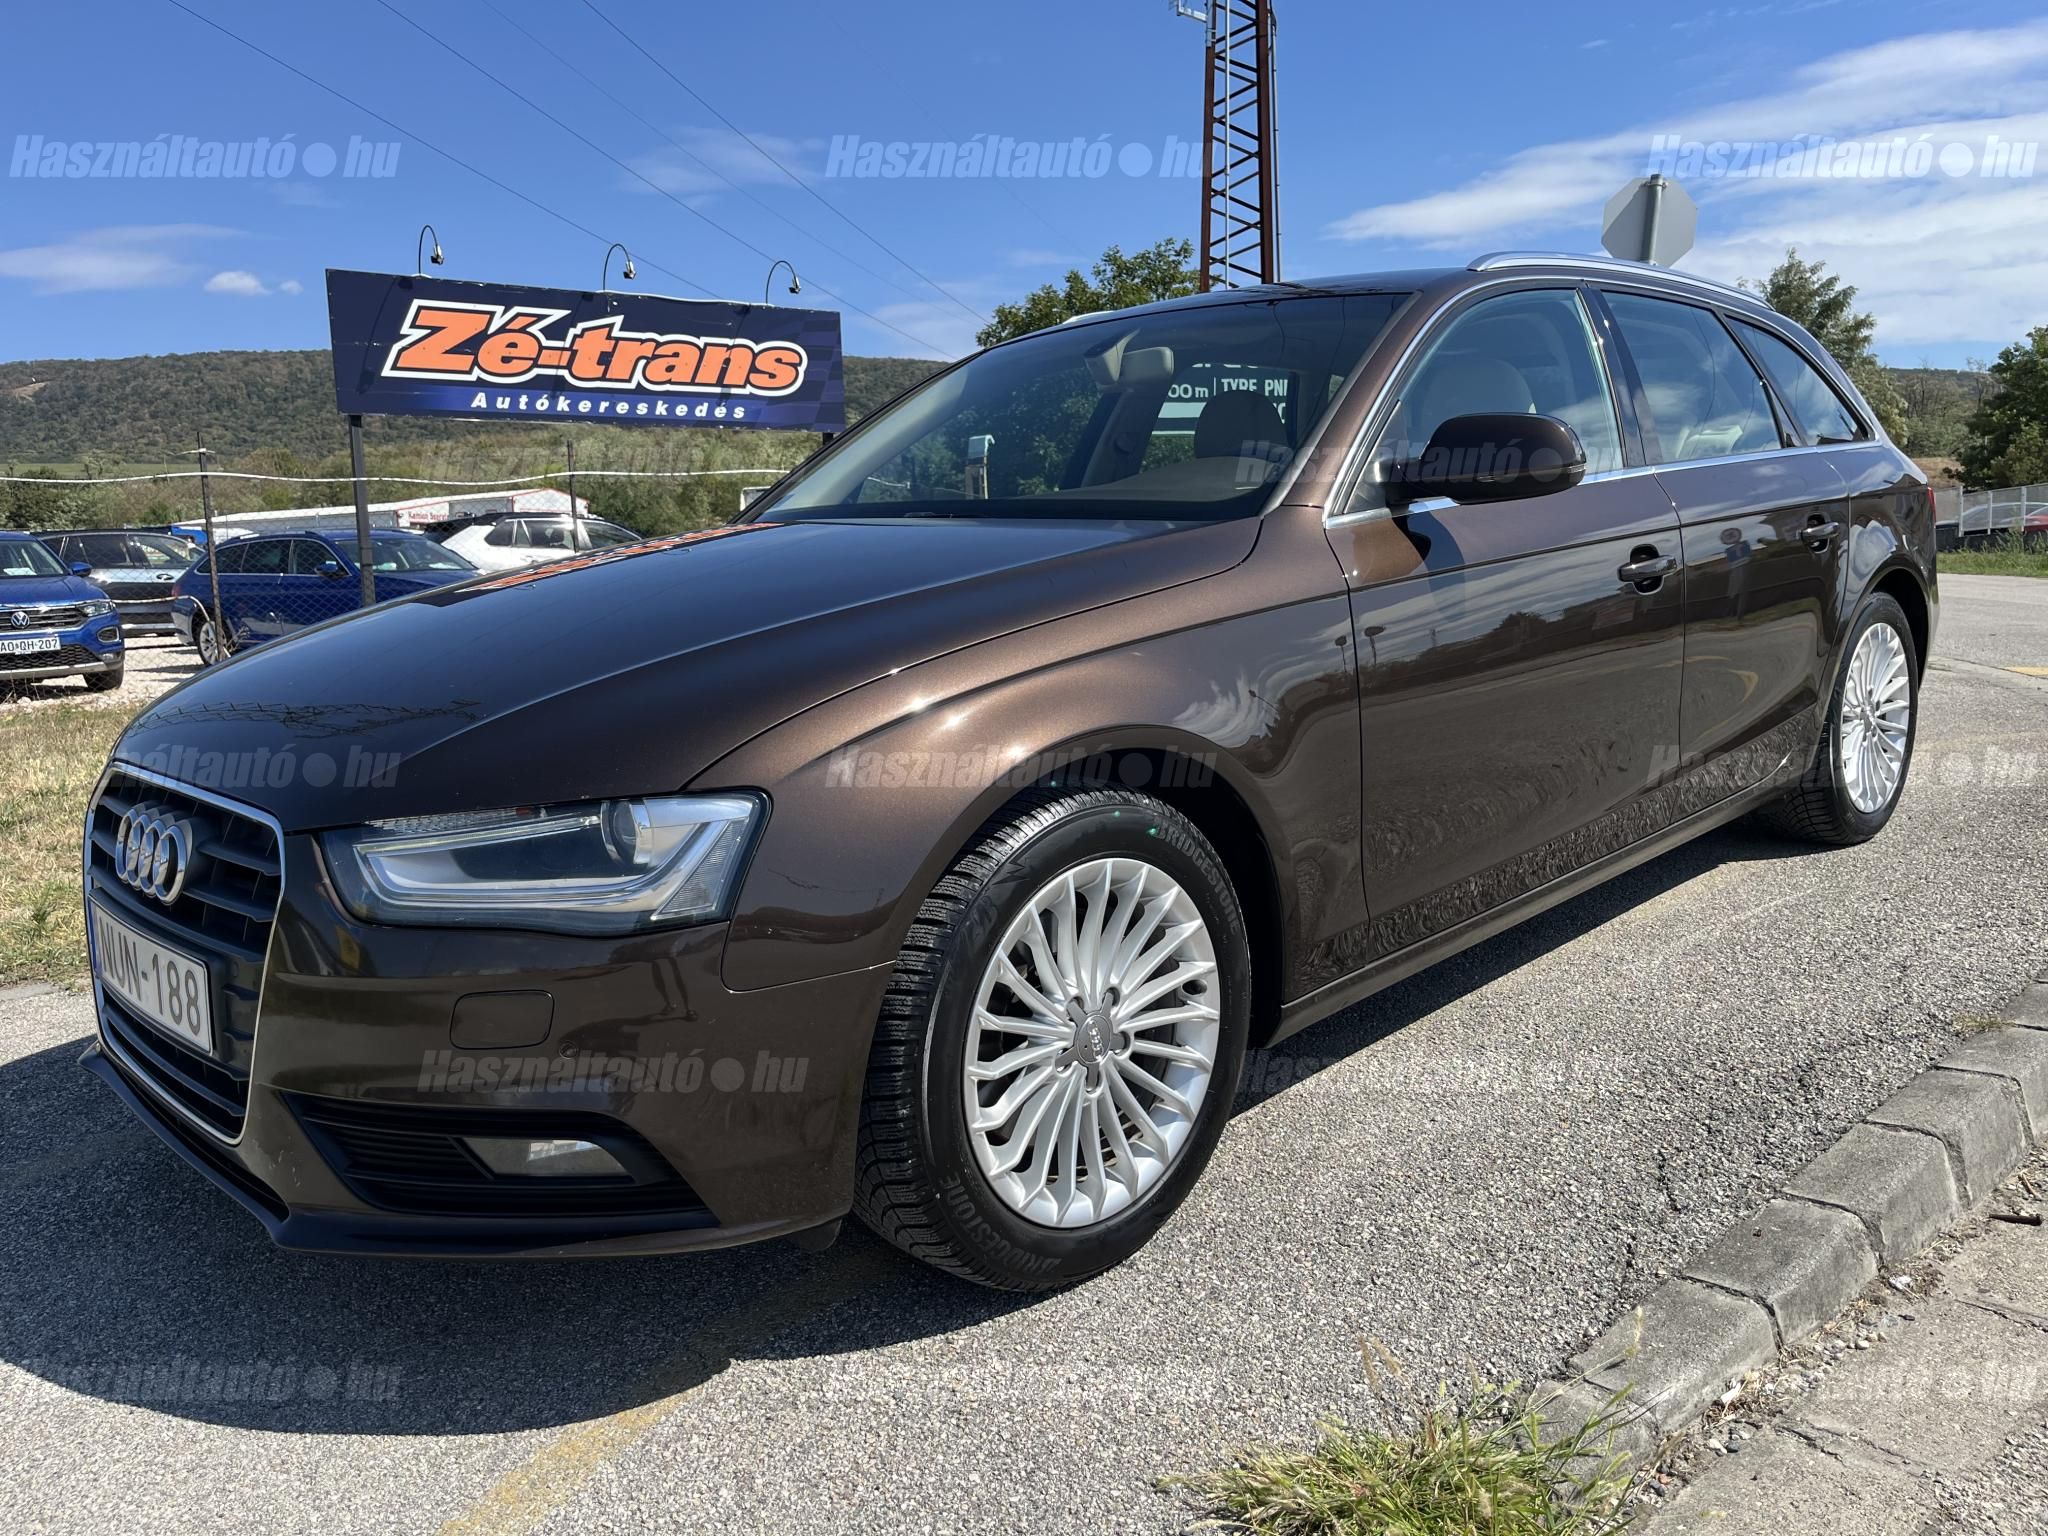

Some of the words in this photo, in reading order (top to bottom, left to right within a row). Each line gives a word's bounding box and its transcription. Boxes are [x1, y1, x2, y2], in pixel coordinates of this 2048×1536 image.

[388, 302, 805, 392] Zé-trans
[470, 390, 747, 419] Autókereskedés
[99, 912, 202, 1037] NUN-188
